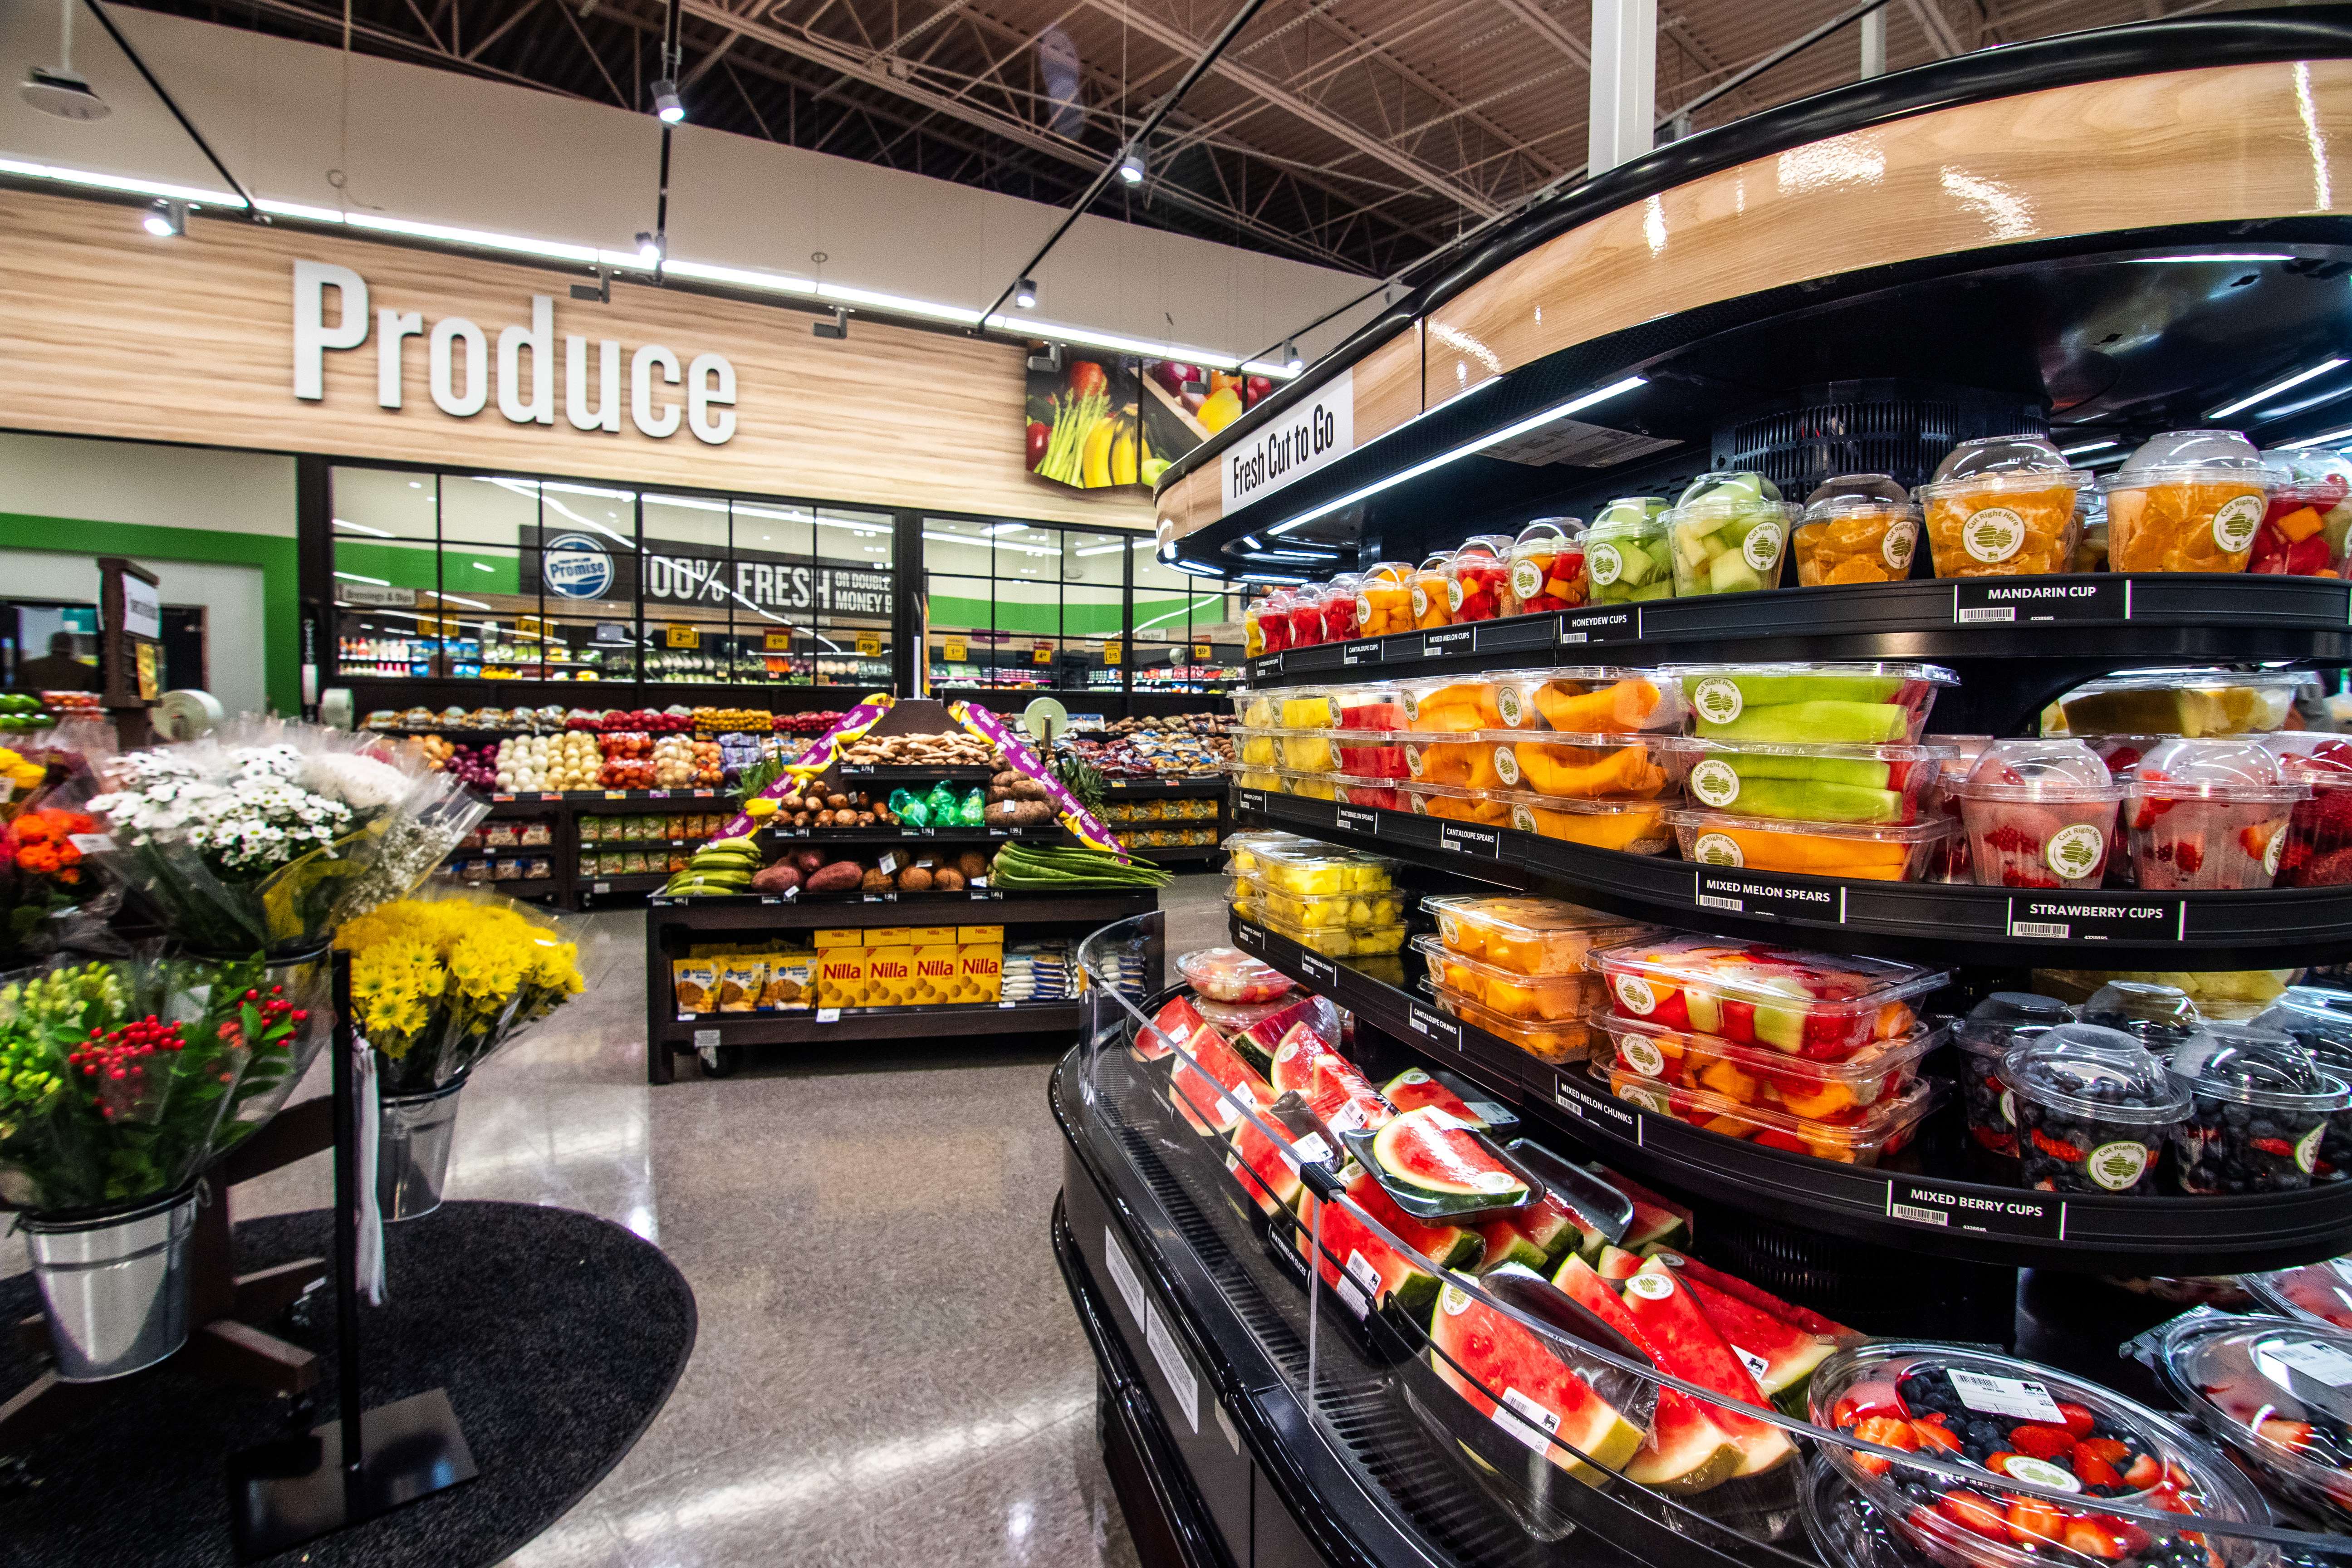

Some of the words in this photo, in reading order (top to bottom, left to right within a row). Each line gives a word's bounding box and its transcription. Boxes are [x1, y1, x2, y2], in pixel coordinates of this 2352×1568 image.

[293, 260, 736, 444] Produce
[1233, 442, 1265, 498] Fresh
[1268, 430, 1291, 479] Cut
[1295, 424, 1309, 465] to
[1313, 404, 1334, 455] Go
[2221, 505, 2234, 517] Cut
[2235, 498, 2252, 509] Right
[1968, 519, 1980, 529] Cut
[1979, 510, 2002, 520] Right
[2002, 512, 2019, 526] Here
[1748, 529, 1758, 540] Cut
[1886, 531, 1895, 541] Cut
[1894, 524, 1909, 532] Right
[1593, 546, 1604, 554] Right
[1604, 545, 1616, 555] Here
[549, 562, 605, 578] Promise
[1526, 562, 1537, 571] Here
[737, 562, 830, 609] FRESH
[835, 572, 850, 588] OR
[852, 573, 891, 591] DOUBLE
[835, 590, 883, 612] MONEY
[1988, 587, 2066, 599] MANDARIN
[2068, 587, 2097, 597] CUP
[1572, 616, 1609, 627] HONEYDEW
[1609, 614, 1627, 624] CUPS
[1443, 633, 1458, 642] MELON
[1348, 644, 1369, 653] CANTALOUPE
[1697, 686, 1705, 696] Cut
[1705, 679, 1722, 687] Right
[1723, 679, 1736, 693] Here
[843, 710, 863, 729] Organic
[977, 709, 995, 728] Organic
[999, 730, 1017, 750] Organic
[1019, 751, 1038, 770] Organic
[1695, 766, 1704, 776] Cut
[1721, 764, 1734, 778] Here
[772, 774, 794, 793] Organic
[1041, 772, 1058, 792] Organic
[1061, 793, 1079, 812] Organic
[1082, 813, 1099, 833] Organic
[1341, 810, 1362, 819] WATERMELON
[1362, 813, 1374, 822] SPEARS
[725, 817, 747, 836] Organic
[1446, 828, 1476, 839] CANTALOUPE
[1476, 833, 1494, 843] SPEARS
[1102, 834, 1120, 853] Organic
[1697, 839, 1707, 849] Cut
[1725, 838, 1737, 851] Here
[2058, 830, 2072, 841] Cut
[2073, 827, 2092, 835] Right
[2092, 831, 2101, 847] Here
[1706, 879, 1741, 892] MIXED
[1743, 884, 1783, 898] MELON
[1785, 889, 1831, 902] SPEARS
[2029, 904, 2127, 917] STRAWBERRY
[2129, 908, 2164, 919] CUPS
[823, 963, 861, 980] Nilla
[870, 962, 907, 978] Nilla
[917, 960, 953, 976] Nilla
[962, 958, 998, 975] Nilla
[1322, 962, 1334, 973] CHUNKS
[1638, 980, 1649, 992] Here
[1414, 1008, 1440, 1027] CANTALOUPE
[1440, 1020, 1457, 1035] CHUNKS
[1561, 1083, 1580, 1099] MIXED
[1580, 1093, 1602, 1111] MELON
[1603, 1104, 1633, 1125] CHUNKS
[2098, 1147, 2112, 1158] Cut
[2113, 1143, 2132, 1152] Right
[1910, 1188, 1956, 1206] MIXED
[1959, 1196, 2004, 1213] BERRY
[2007, 1203, 2043, 1217] CUPS
[1271, 1230, 1294, 1262] WATERMELON
[1293, 1256, 1306, 1276] SLICES
